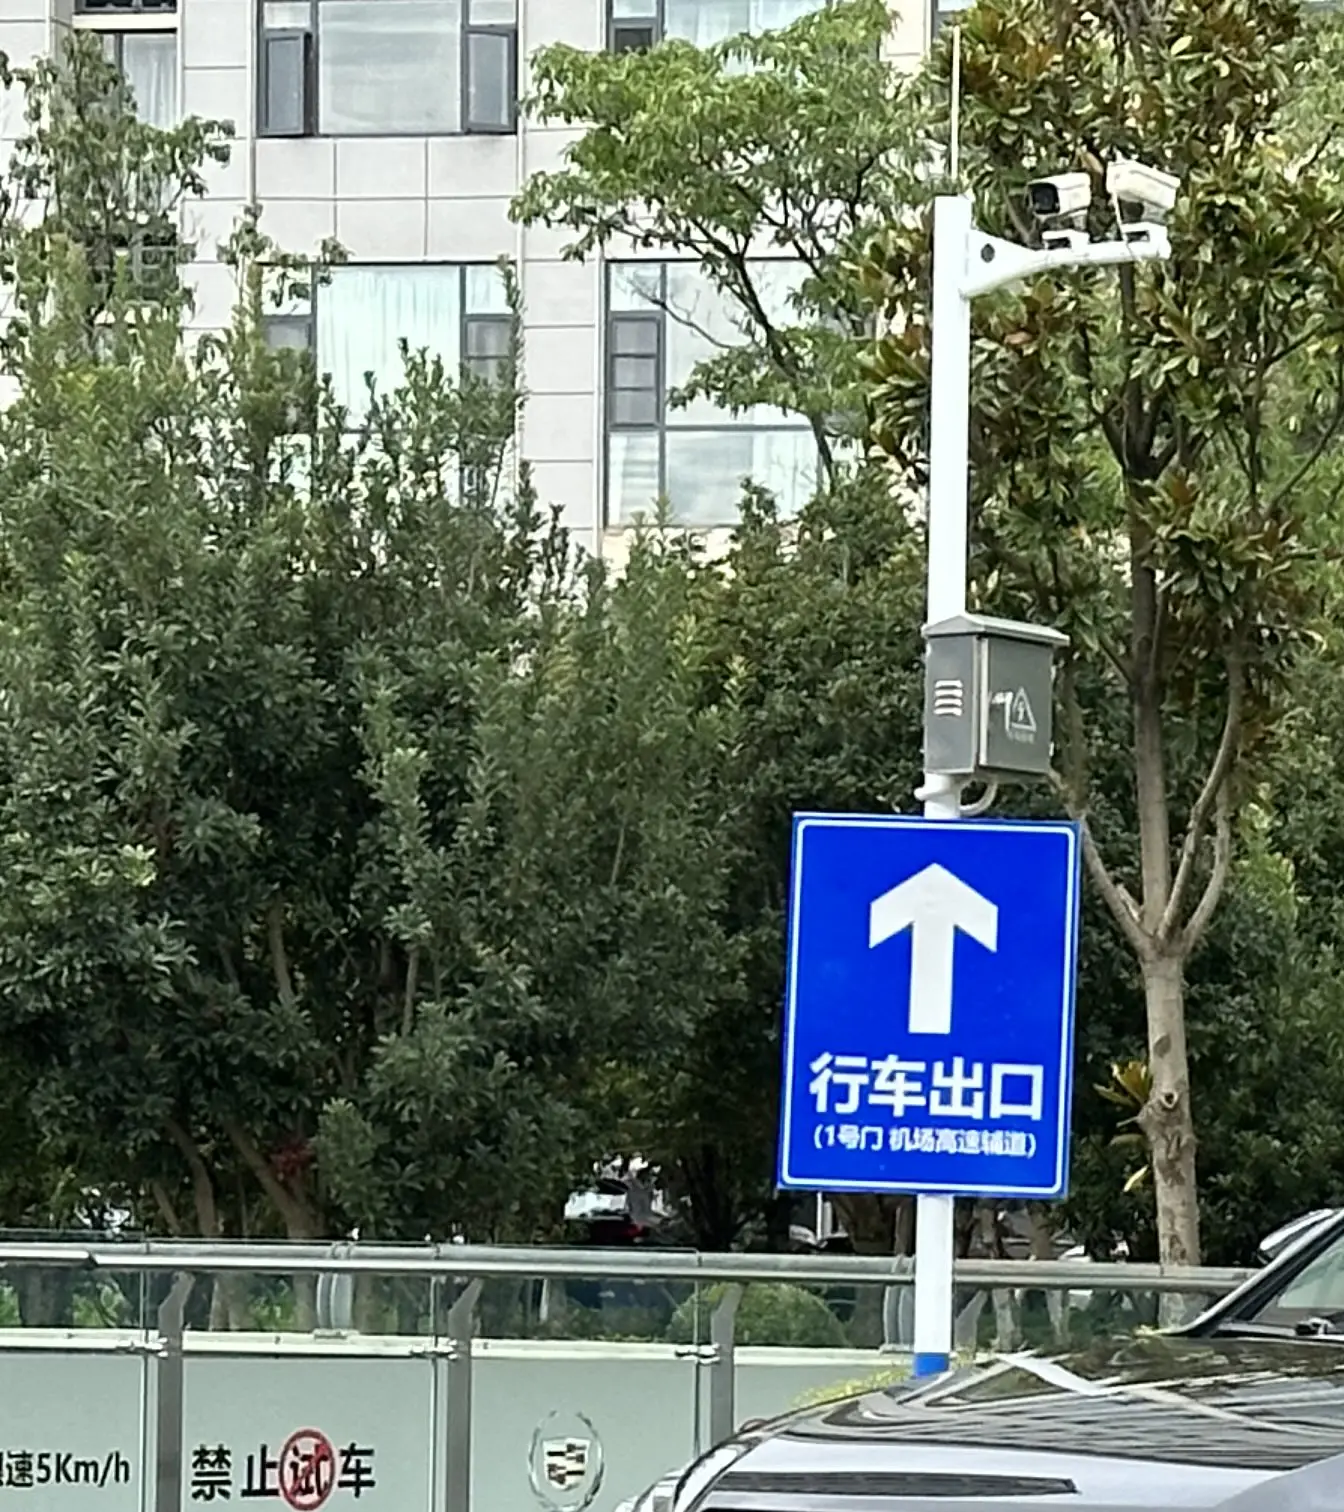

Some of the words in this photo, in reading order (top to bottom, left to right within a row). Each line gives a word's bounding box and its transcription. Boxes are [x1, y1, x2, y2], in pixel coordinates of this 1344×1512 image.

[809, 1051, 1044, 1120] 行车出口
[0, 1450, 130, 1488] 速5Km/h
[191, 1442, 376, 1501] 禁止试车
